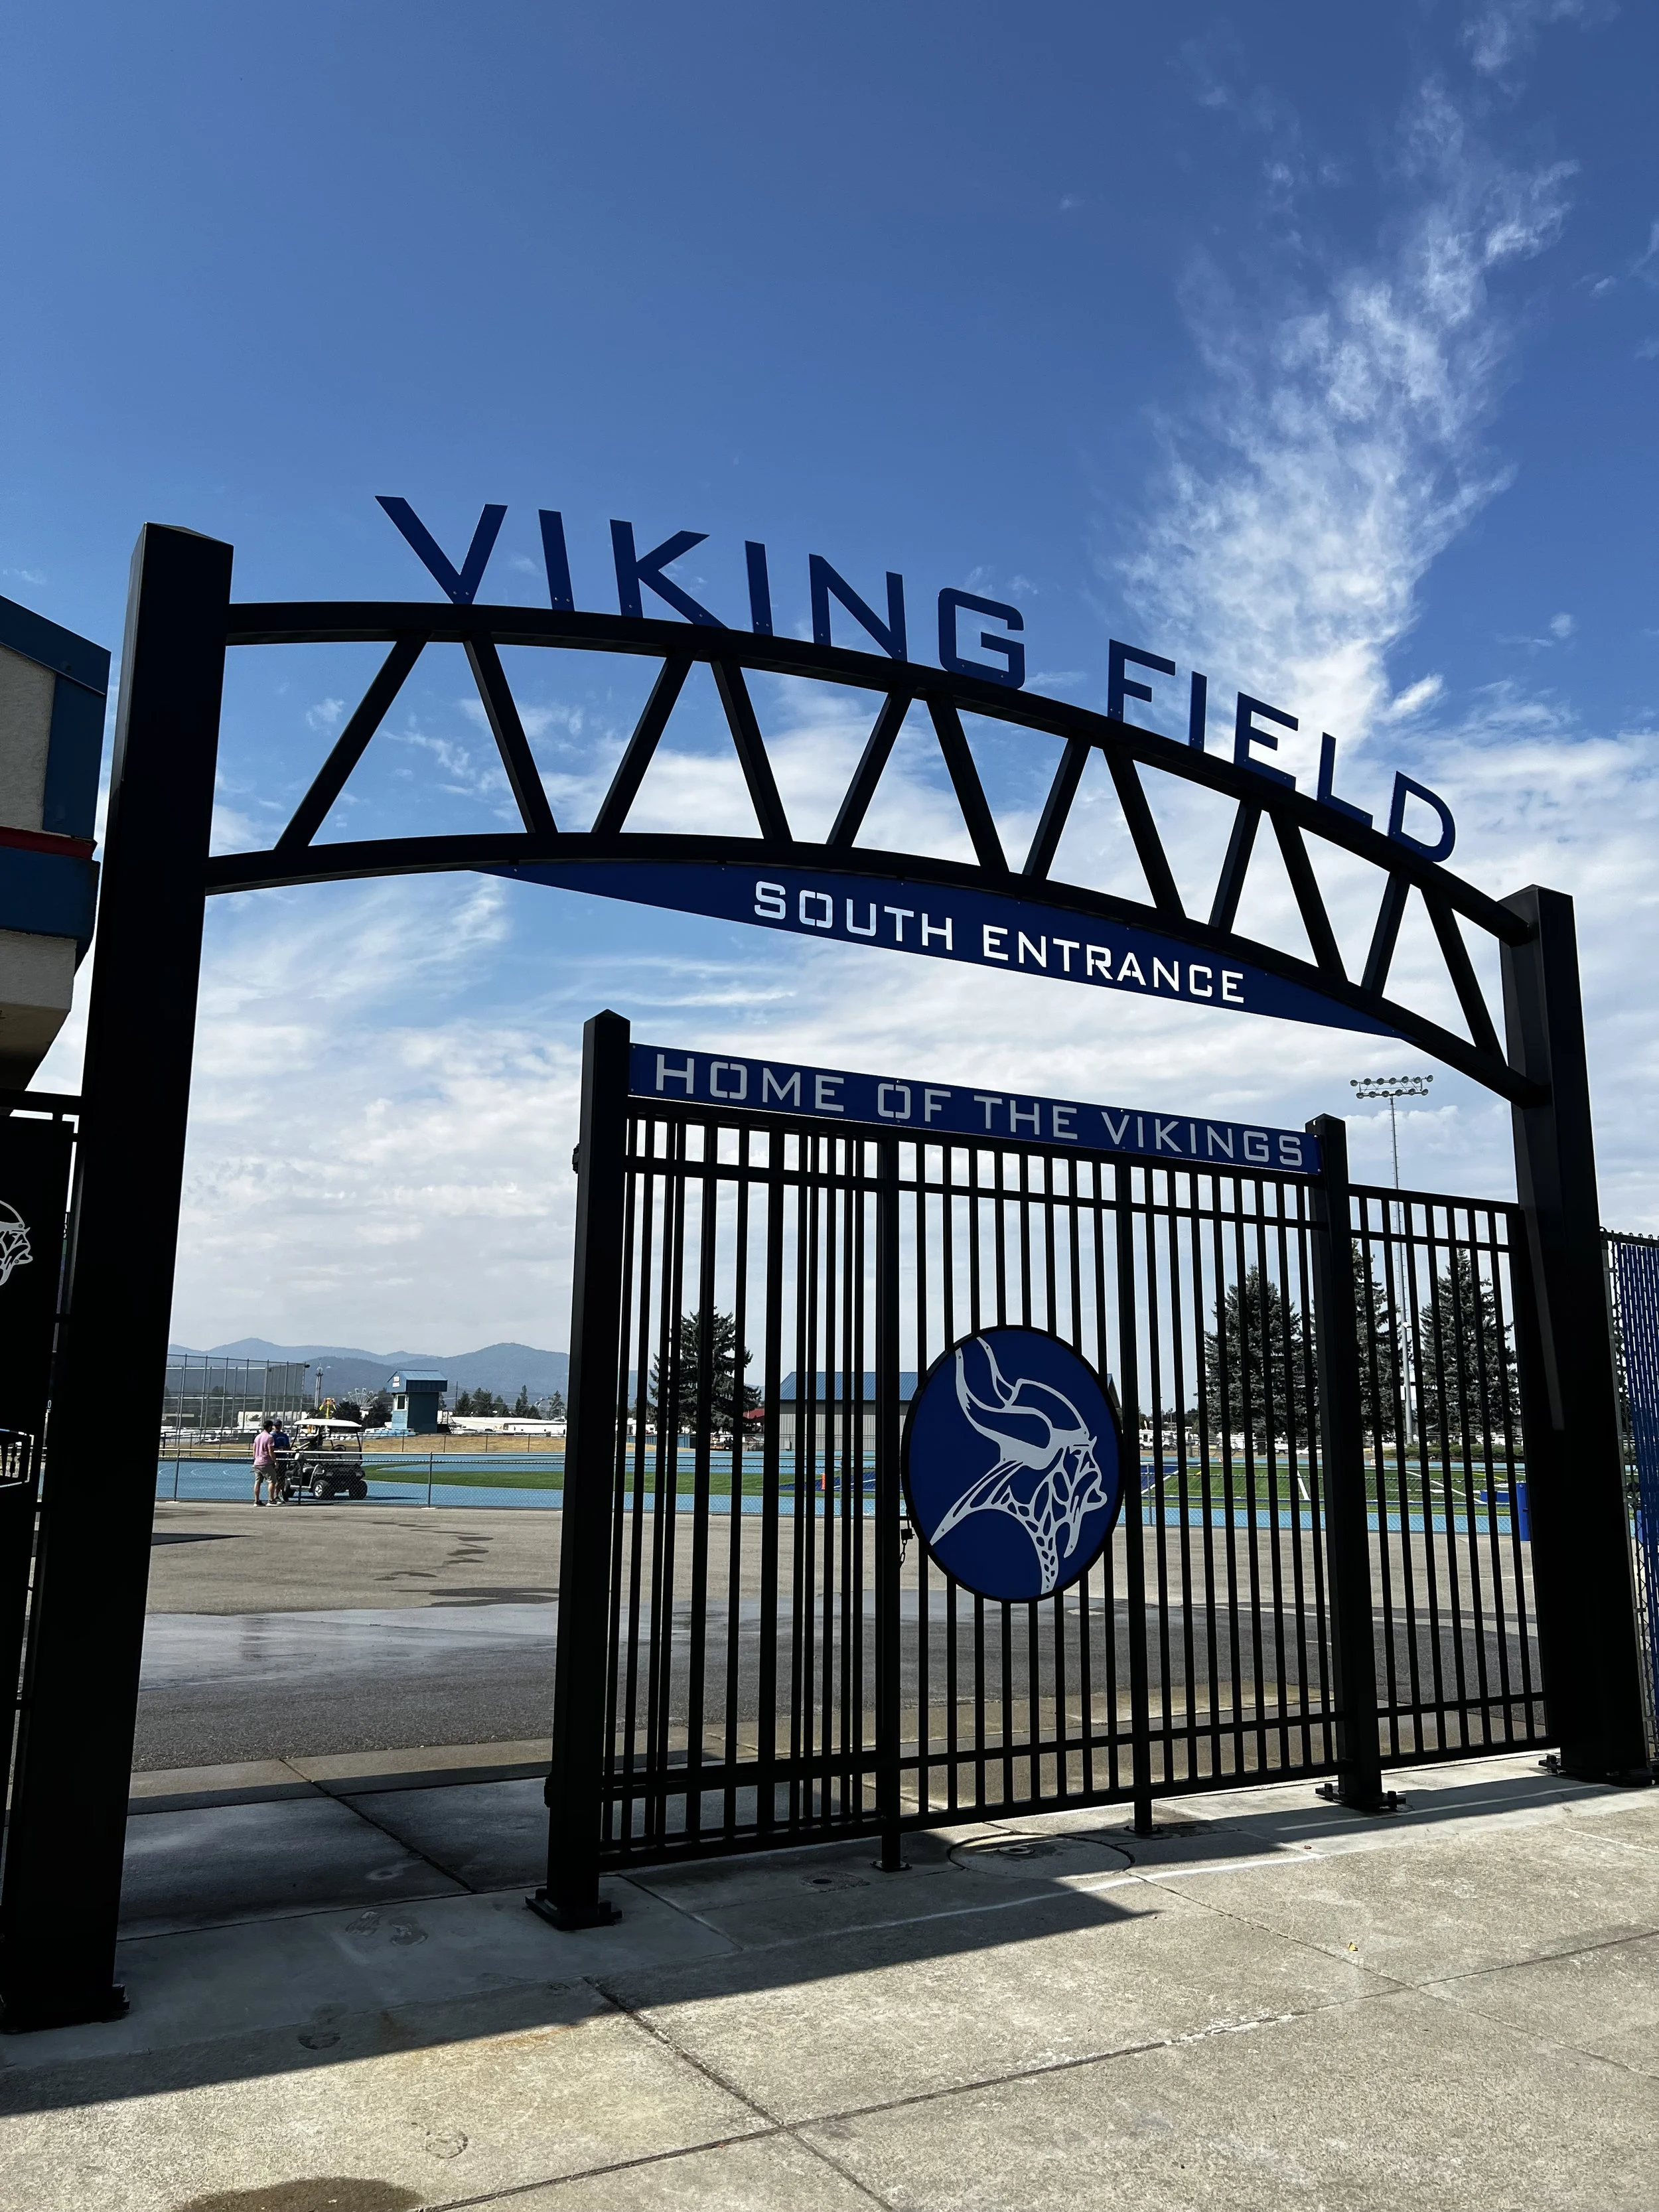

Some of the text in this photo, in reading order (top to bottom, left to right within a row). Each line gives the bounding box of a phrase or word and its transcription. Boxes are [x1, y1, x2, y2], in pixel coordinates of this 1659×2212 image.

[375, 495, 1456, 863] VIKING FIELD
[754, 881, 1245, 1003] SOUTH ENTRANCE
[656, 1054, 1303, 1167] HOME OF THE VIKINGS
